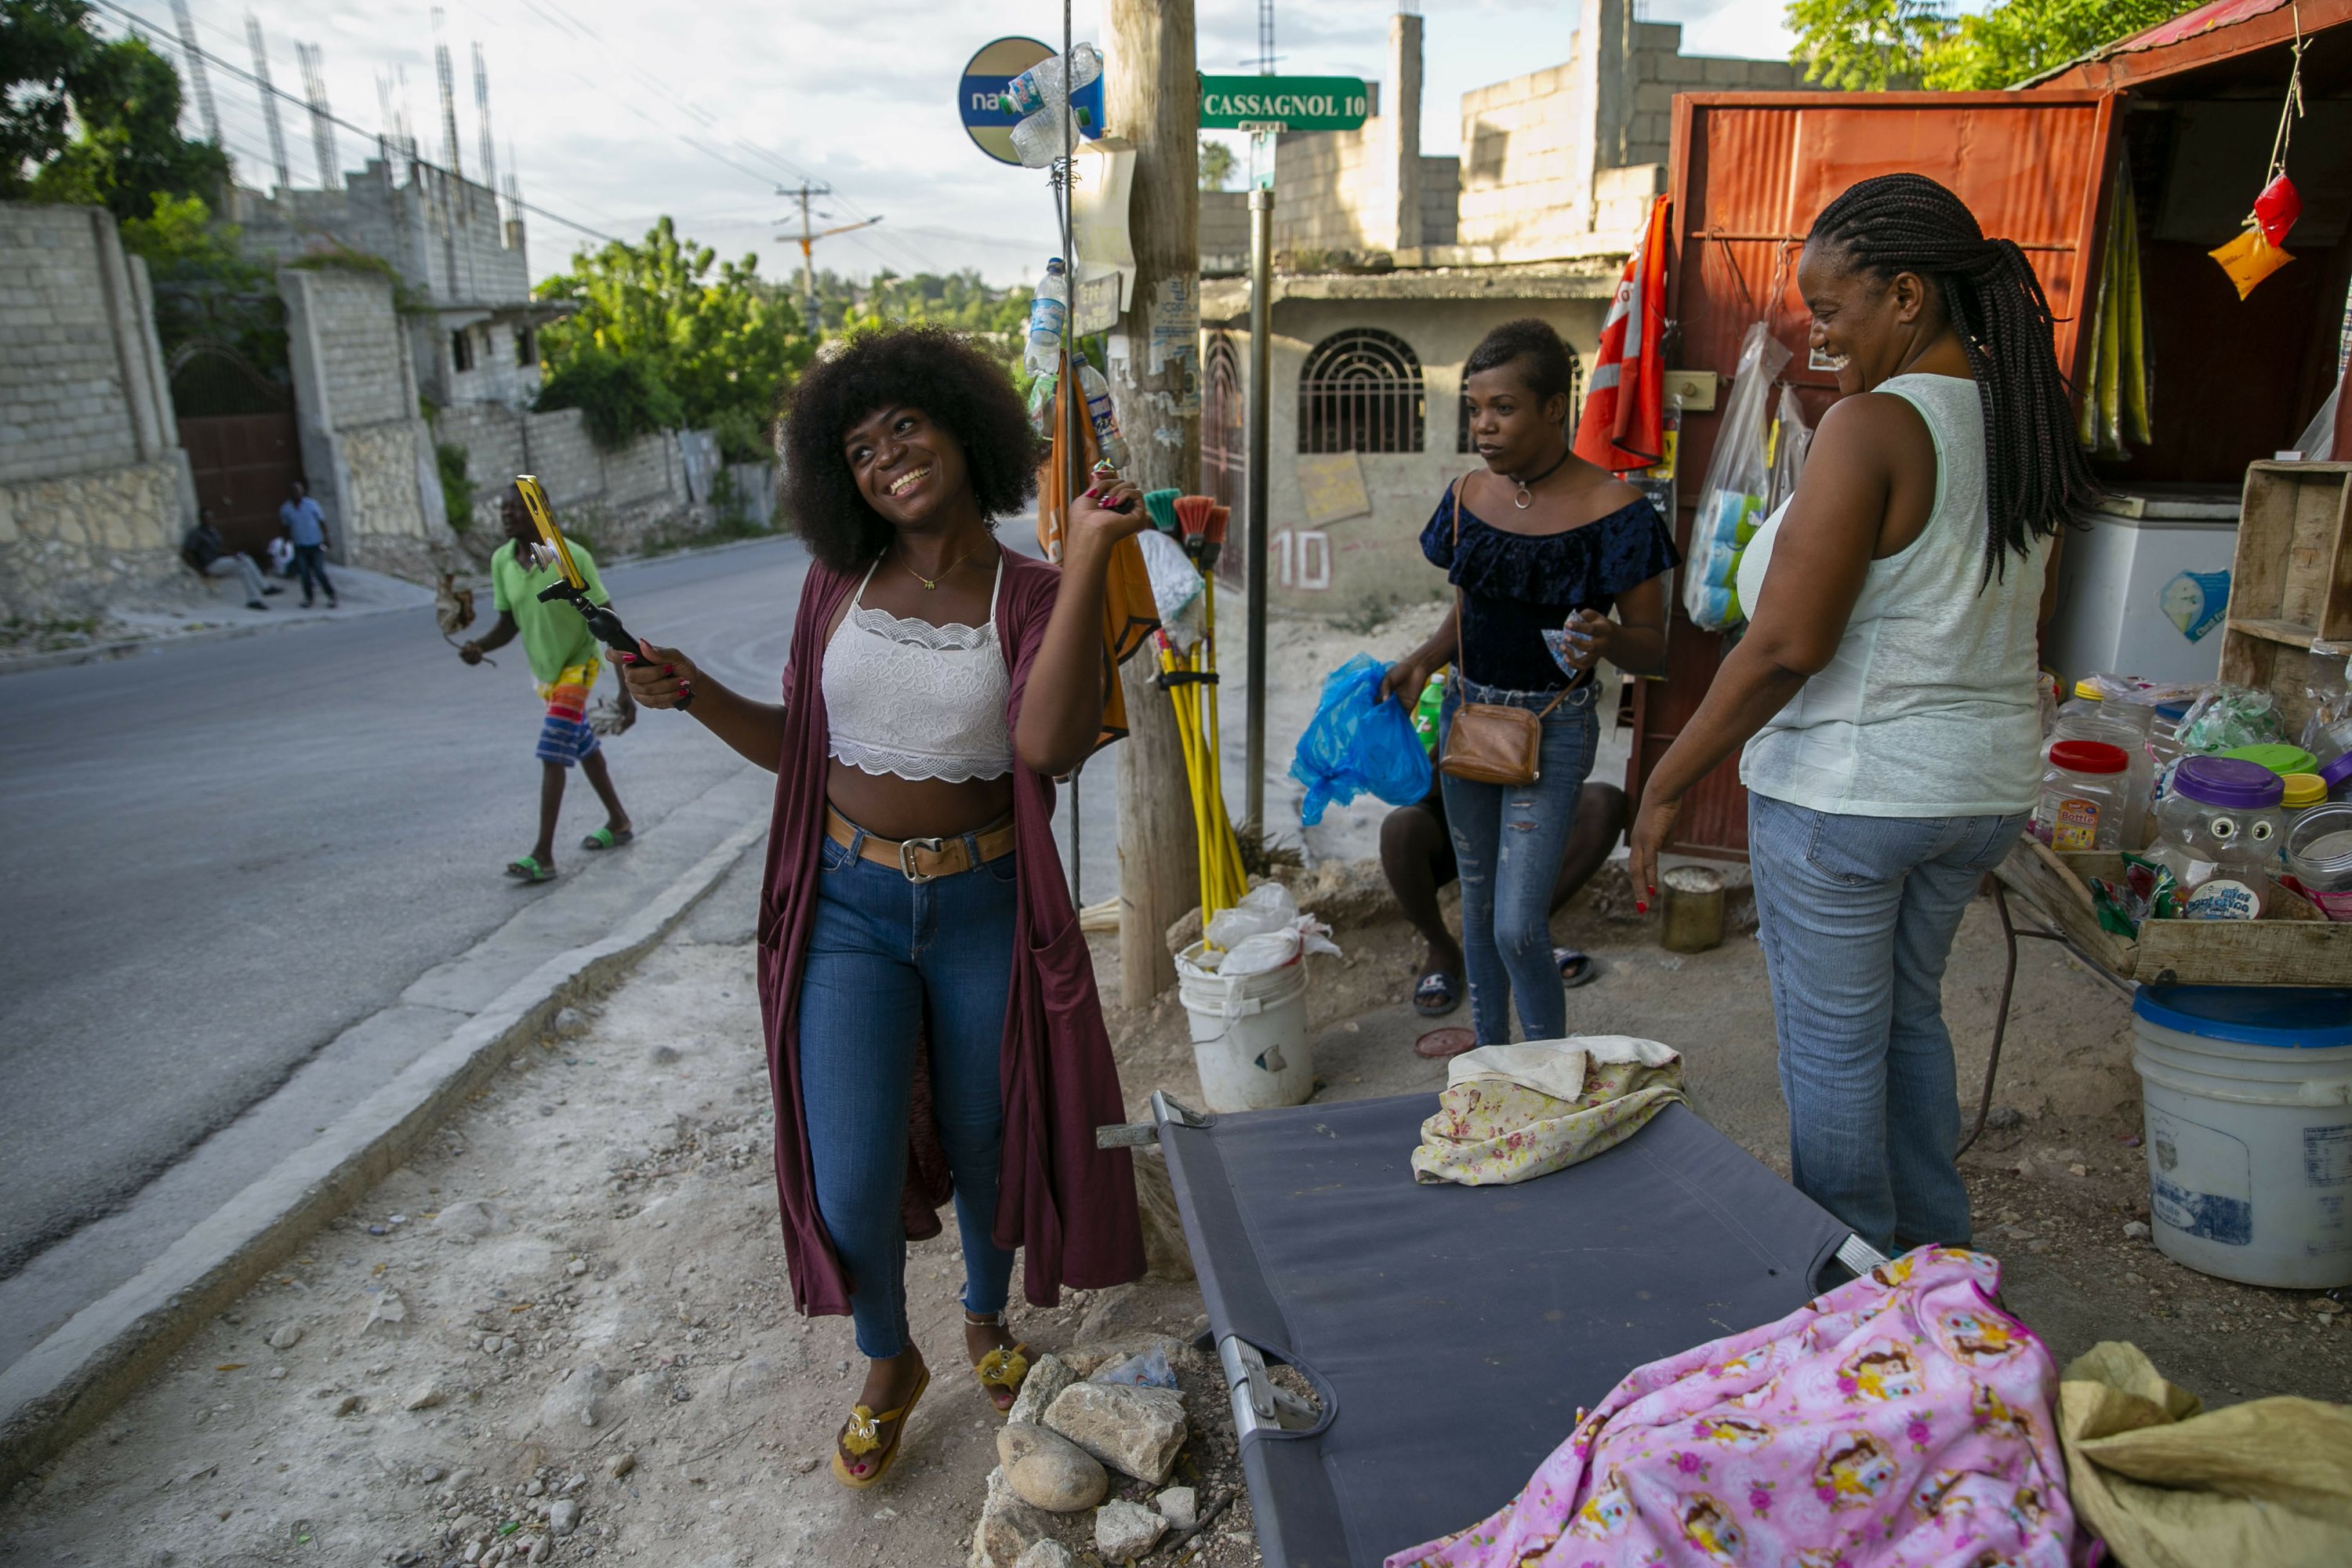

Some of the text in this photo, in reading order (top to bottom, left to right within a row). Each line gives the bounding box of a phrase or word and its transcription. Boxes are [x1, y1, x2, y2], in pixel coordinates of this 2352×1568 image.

[1203, 94, 1365, 117] CASSAGNOL 10
[1268, 525, 1331, 590] 10
[2061, 811, 2095, 825] Bottle
